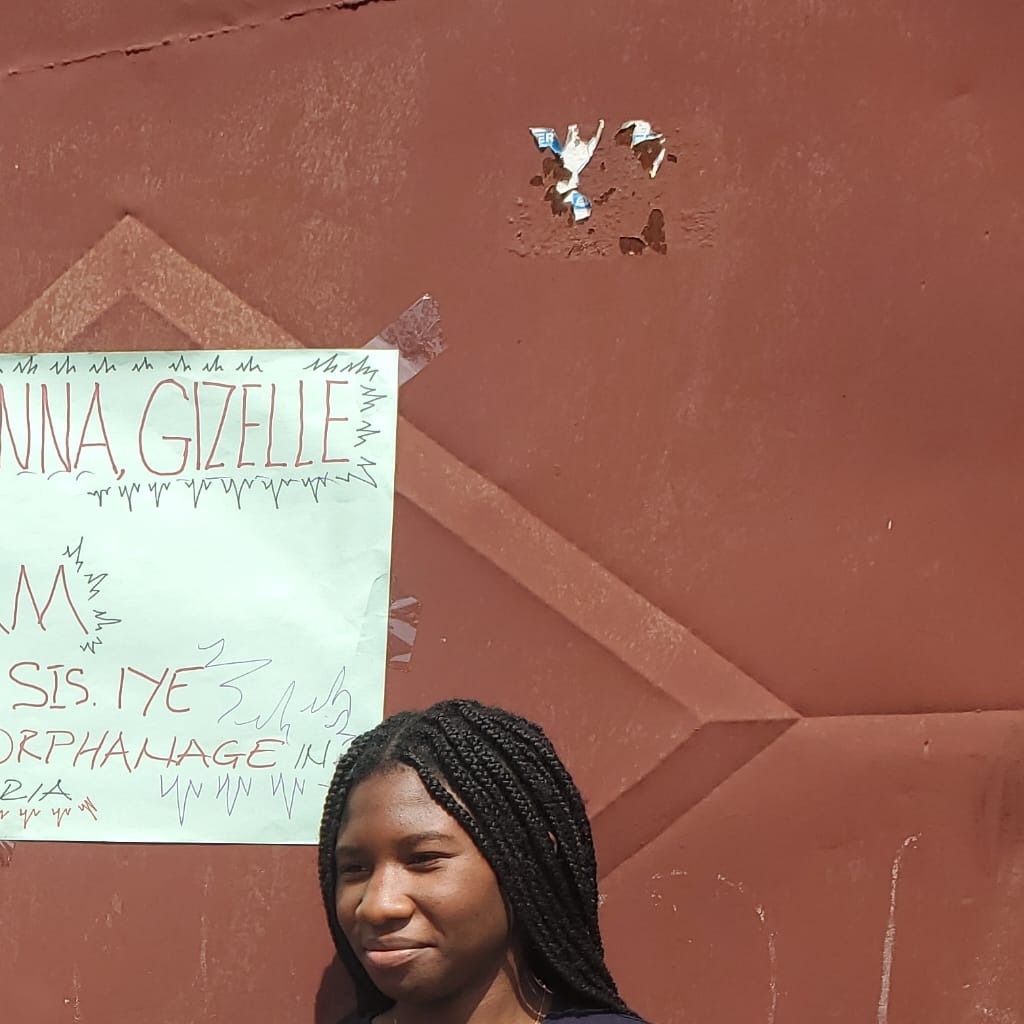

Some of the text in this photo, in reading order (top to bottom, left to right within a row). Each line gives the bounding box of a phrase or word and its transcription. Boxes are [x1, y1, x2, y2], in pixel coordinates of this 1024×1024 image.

[138, 378, 350, 476] GIZELLE
[8, 661, 97, 710] SIS.
[117, 665, 205, 717] IYE
[293, 739, 332, 769] IN
